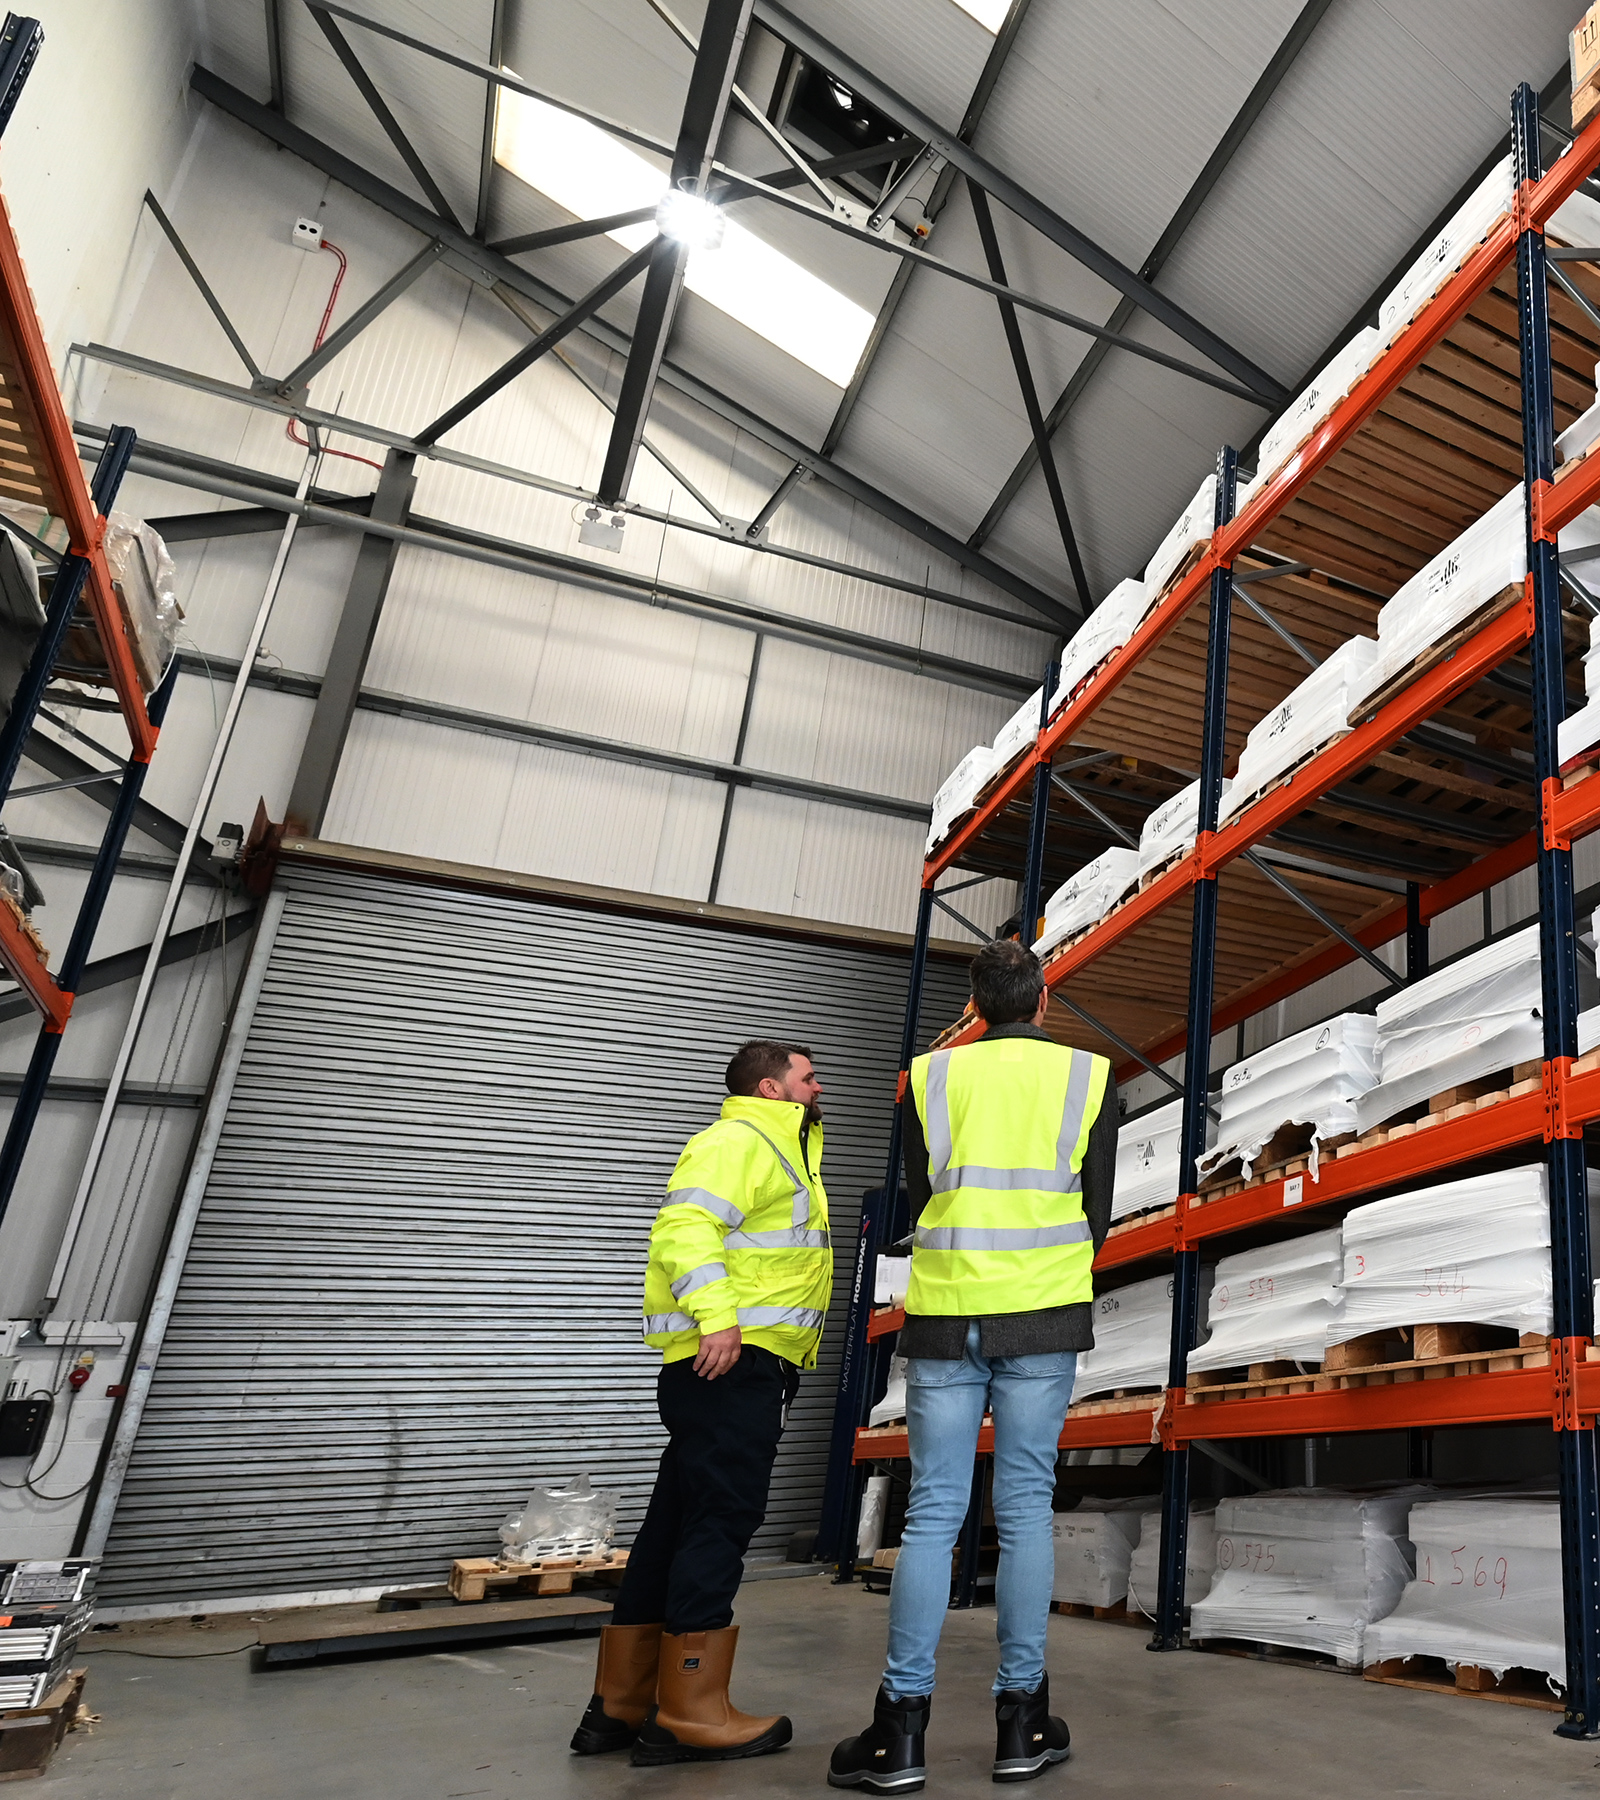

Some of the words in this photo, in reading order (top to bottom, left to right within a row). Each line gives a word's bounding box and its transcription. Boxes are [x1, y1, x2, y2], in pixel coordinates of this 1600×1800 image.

[853, 1237, 867, 1303] ROBOPAC
[1353, 1255, 1365, 1276] 3
[841, 1306, 859, 1393] MASTERPLAT
[1240, 1544, 1276, 1572] 575
[1422, 1556, 1435, 1585] 1
[1450, 1545, 1508, 1600] 569
